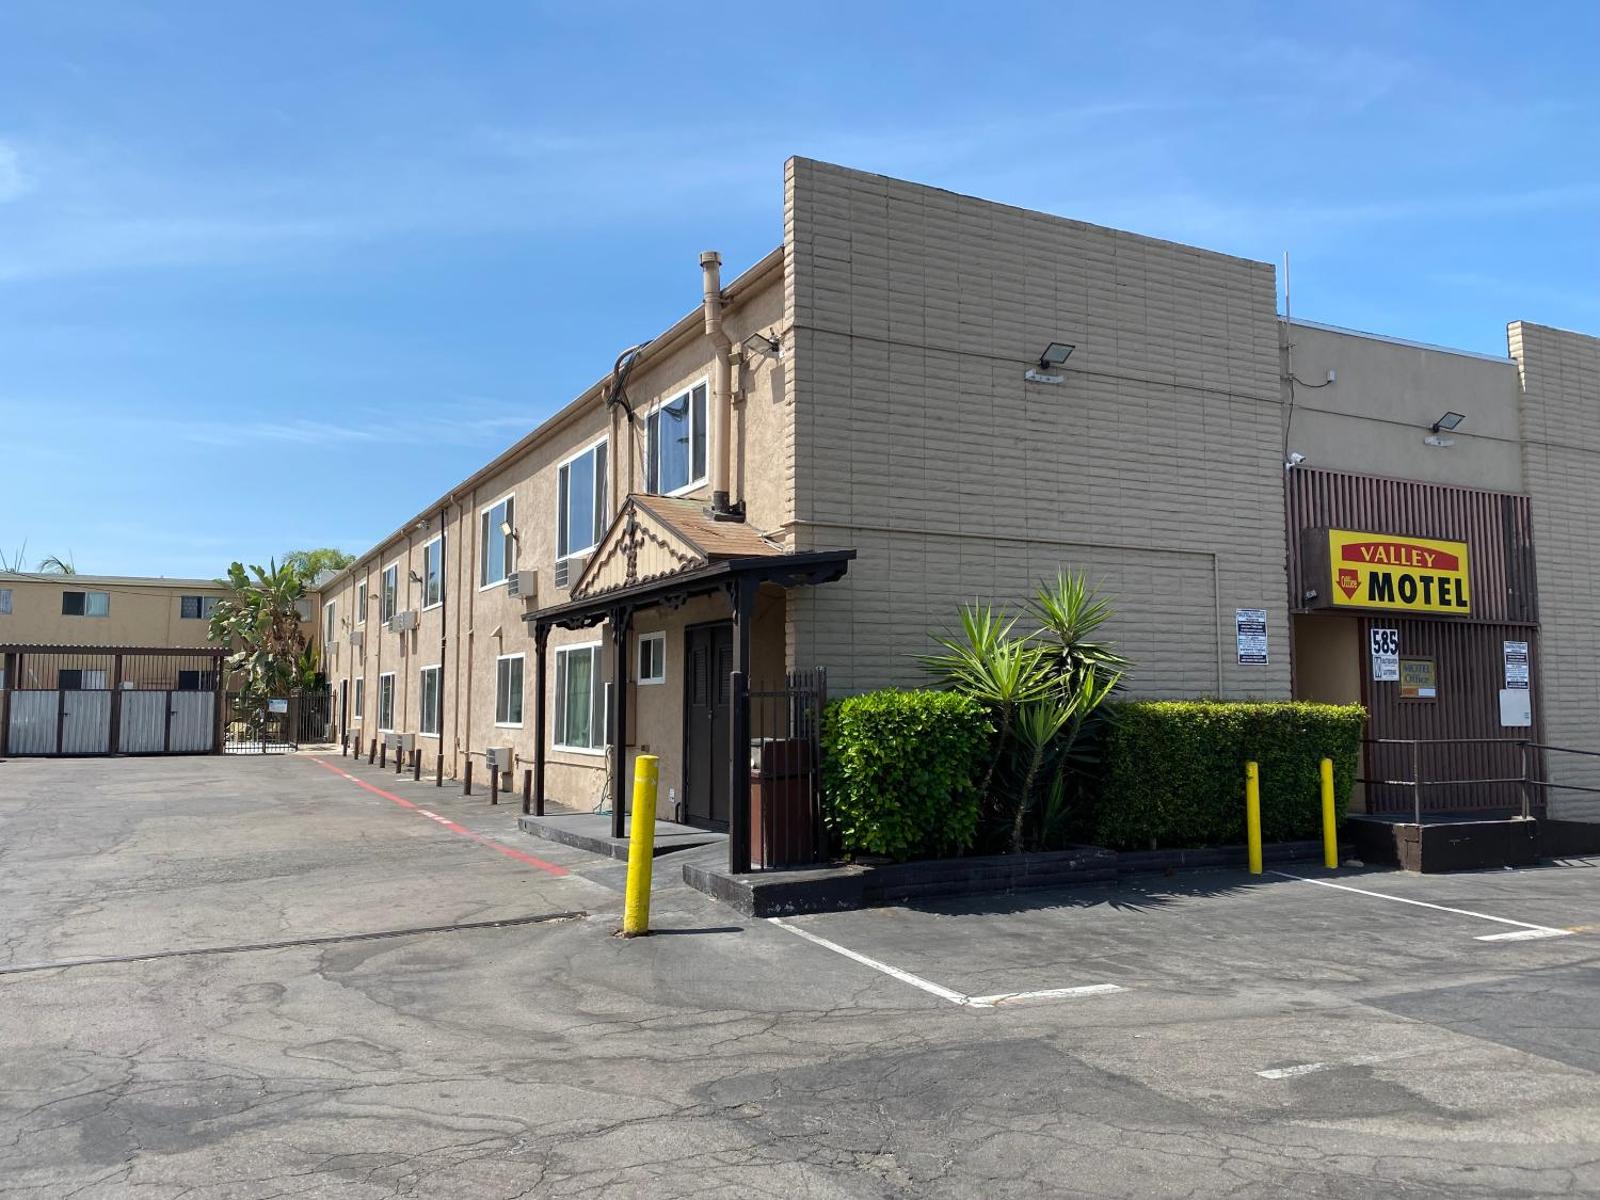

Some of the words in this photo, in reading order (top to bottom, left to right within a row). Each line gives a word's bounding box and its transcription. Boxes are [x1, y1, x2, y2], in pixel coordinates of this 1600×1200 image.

[1360, 545, 1436, 567] VALLEY
[1367, 571, 1468, 607] MOTEL
[1372, 630, 1399, 655] 585
